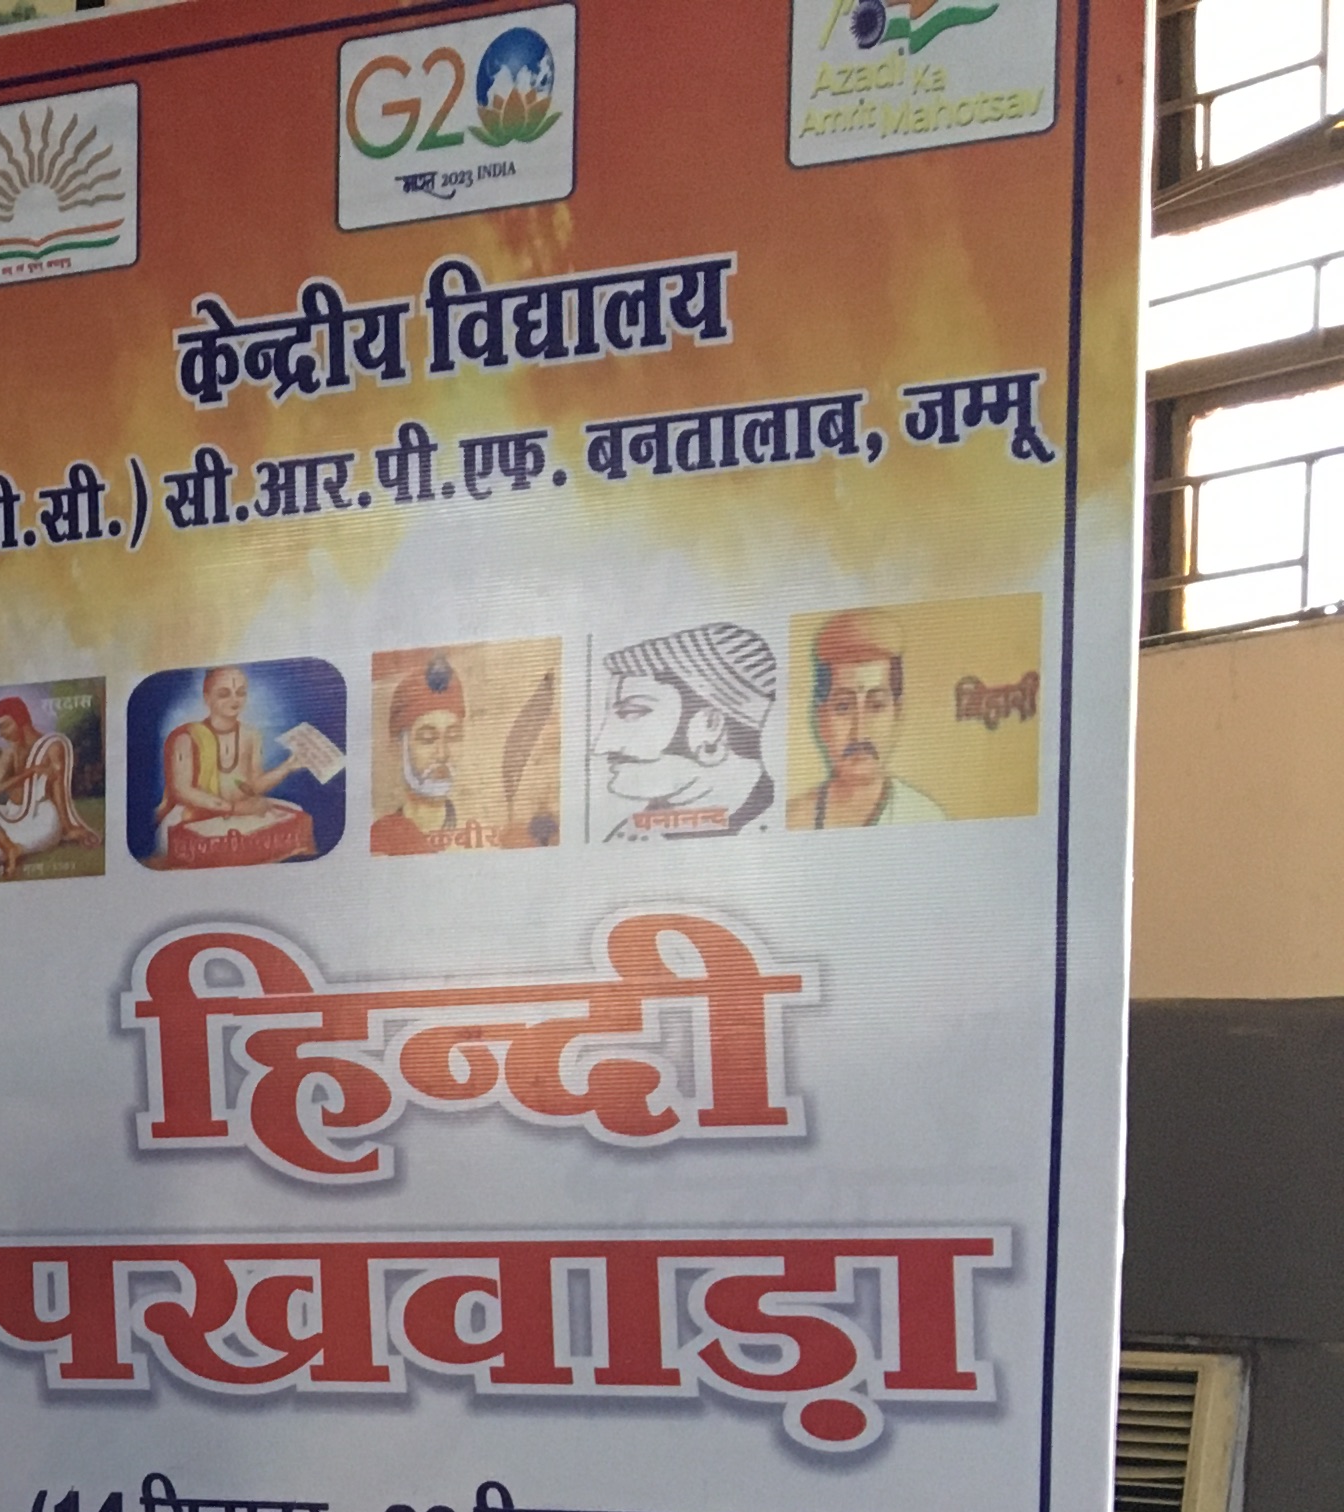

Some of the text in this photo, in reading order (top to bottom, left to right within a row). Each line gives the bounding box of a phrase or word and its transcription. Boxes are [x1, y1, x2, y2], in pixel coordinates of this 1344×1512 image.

[798, 86, 1044, 138] Amrit Mahotsav
[810, 48, 948, 100] Azadi Ka
[441, 170, 473, 188] 2023
[477, 160, 516, 179] INDIA
[178, 257, 733, 402] केन्द्रीय विद्यालय
[585, 393, 886, 481] बनतालाब,
[903, 372, 1057, 465] जम्मू
[132, 912, 803, 1176] हिन्दी
